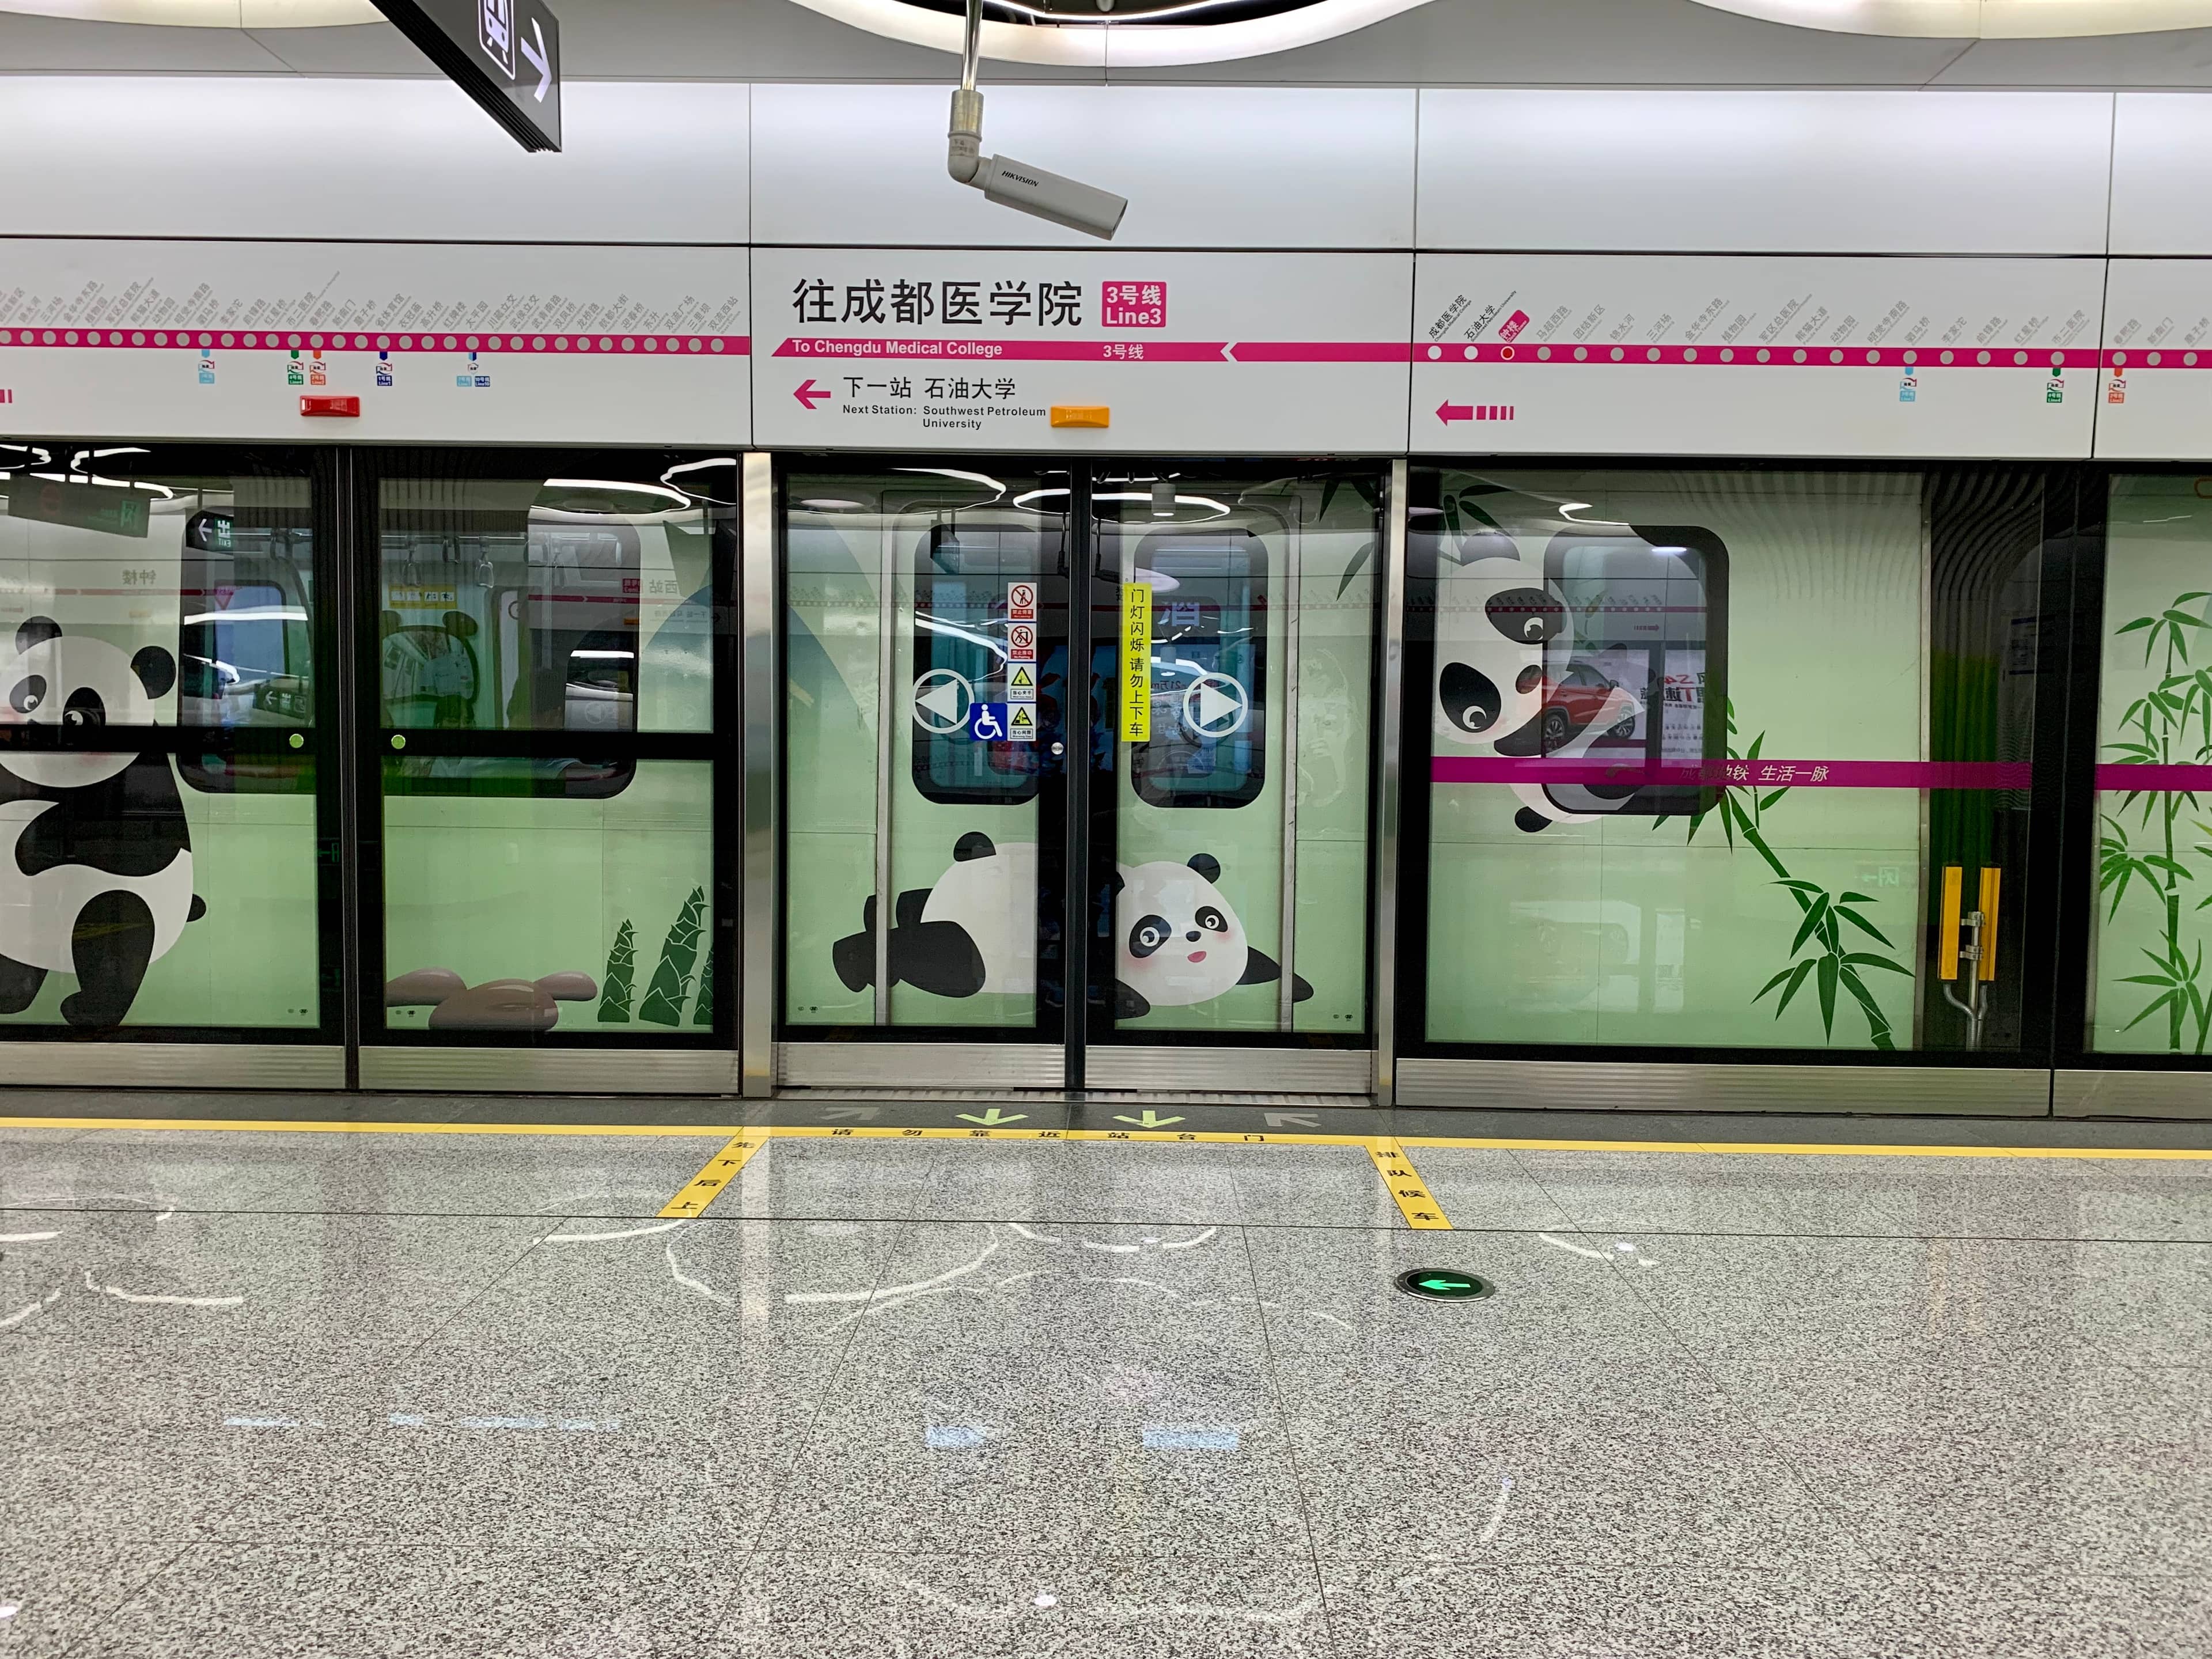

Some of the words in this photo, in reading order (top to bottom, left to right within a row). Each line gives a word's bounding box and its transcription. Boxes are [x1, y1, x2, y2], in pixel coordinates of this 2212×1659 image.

[1002, 171, 1039, 187] HIKVISION
[793, 278, 1082, 326] 往成都医学院
[1107, 285, 1162, 305] 3号线
[420, 300, 443, 328] 高升桥
[465, 300, 488, 328] 太平园
[509, 294, 539, 329] 武侯立交
[553, 301, 577, 329] 双凤桥
[577, 302, 600, 329] 龙桥路
[621, 302, 645, 329] 迎春桥
[642, 310, 660, 330] 东升
[664, 295, 695, 330] 双流广场
[687, 303, 711, 330] 三里坝
[707, 296, 738, 331] 双流西站
[1107, 307, 1161, 324] Line3
[1428, 294, 1467, 339] 成都医学院
[1447, 312, 1461, 327] Medical
[1463, 304, 1495, 339] 石油大学
[1536, 305, 1569, 340] 马超西路
[1573, 304, 1605, 340] 团结新区
[1684, 297, 1723, 341] 金华寺东路
[1758, 298, 1799, 342] 军区总医院
[1794, 306, 1828, 342] 熊猫大道
[1866, 300, 1907, 343] 昭觉寺南路
[1500, 320, 1519, 339] 钟楼
[1609, 313, 1635, 340] 锦水河
[1646, 313, 1672, 341] 三河场
[1721, 314, 1747, 342] 植物园
[1830, 315, 1856, 343] 动物园
[1941, 316, 1967, 344] 李家沱
[2014, 316, 2040, 344] 红星桥
[2051, 309, 2085, 344] 市二医院
[793, 340, 810, 353] To
[815, 340, 881, 356] Chengdu
[886, 341, 942, 354] Medical
[946, 342, 1003, 357] College
[1103, 344, 1144, 359] 3号线
[843, 377, 912, 399] 下一站
[924, 377, 1016, 400] 石油大学
[843, 405, 869, 414] Next
[872, 405, 917, 415] Station:
[923, 406, 984, 416] Southwest
[987, 407, 1046, 416] Petroleum
[923, 419, 982, 430] University
[1129, 588, 1145, 737] 门灯闪烁请勿上下车
[1758, 765, 1830, 782] 生活一脉
[832, 1128, 1264, 1142] 请勿靠近站台门
[671, 1142, 756, 1209] 先下后上
[1374, 1152, 1439, 1221] 排队候车
